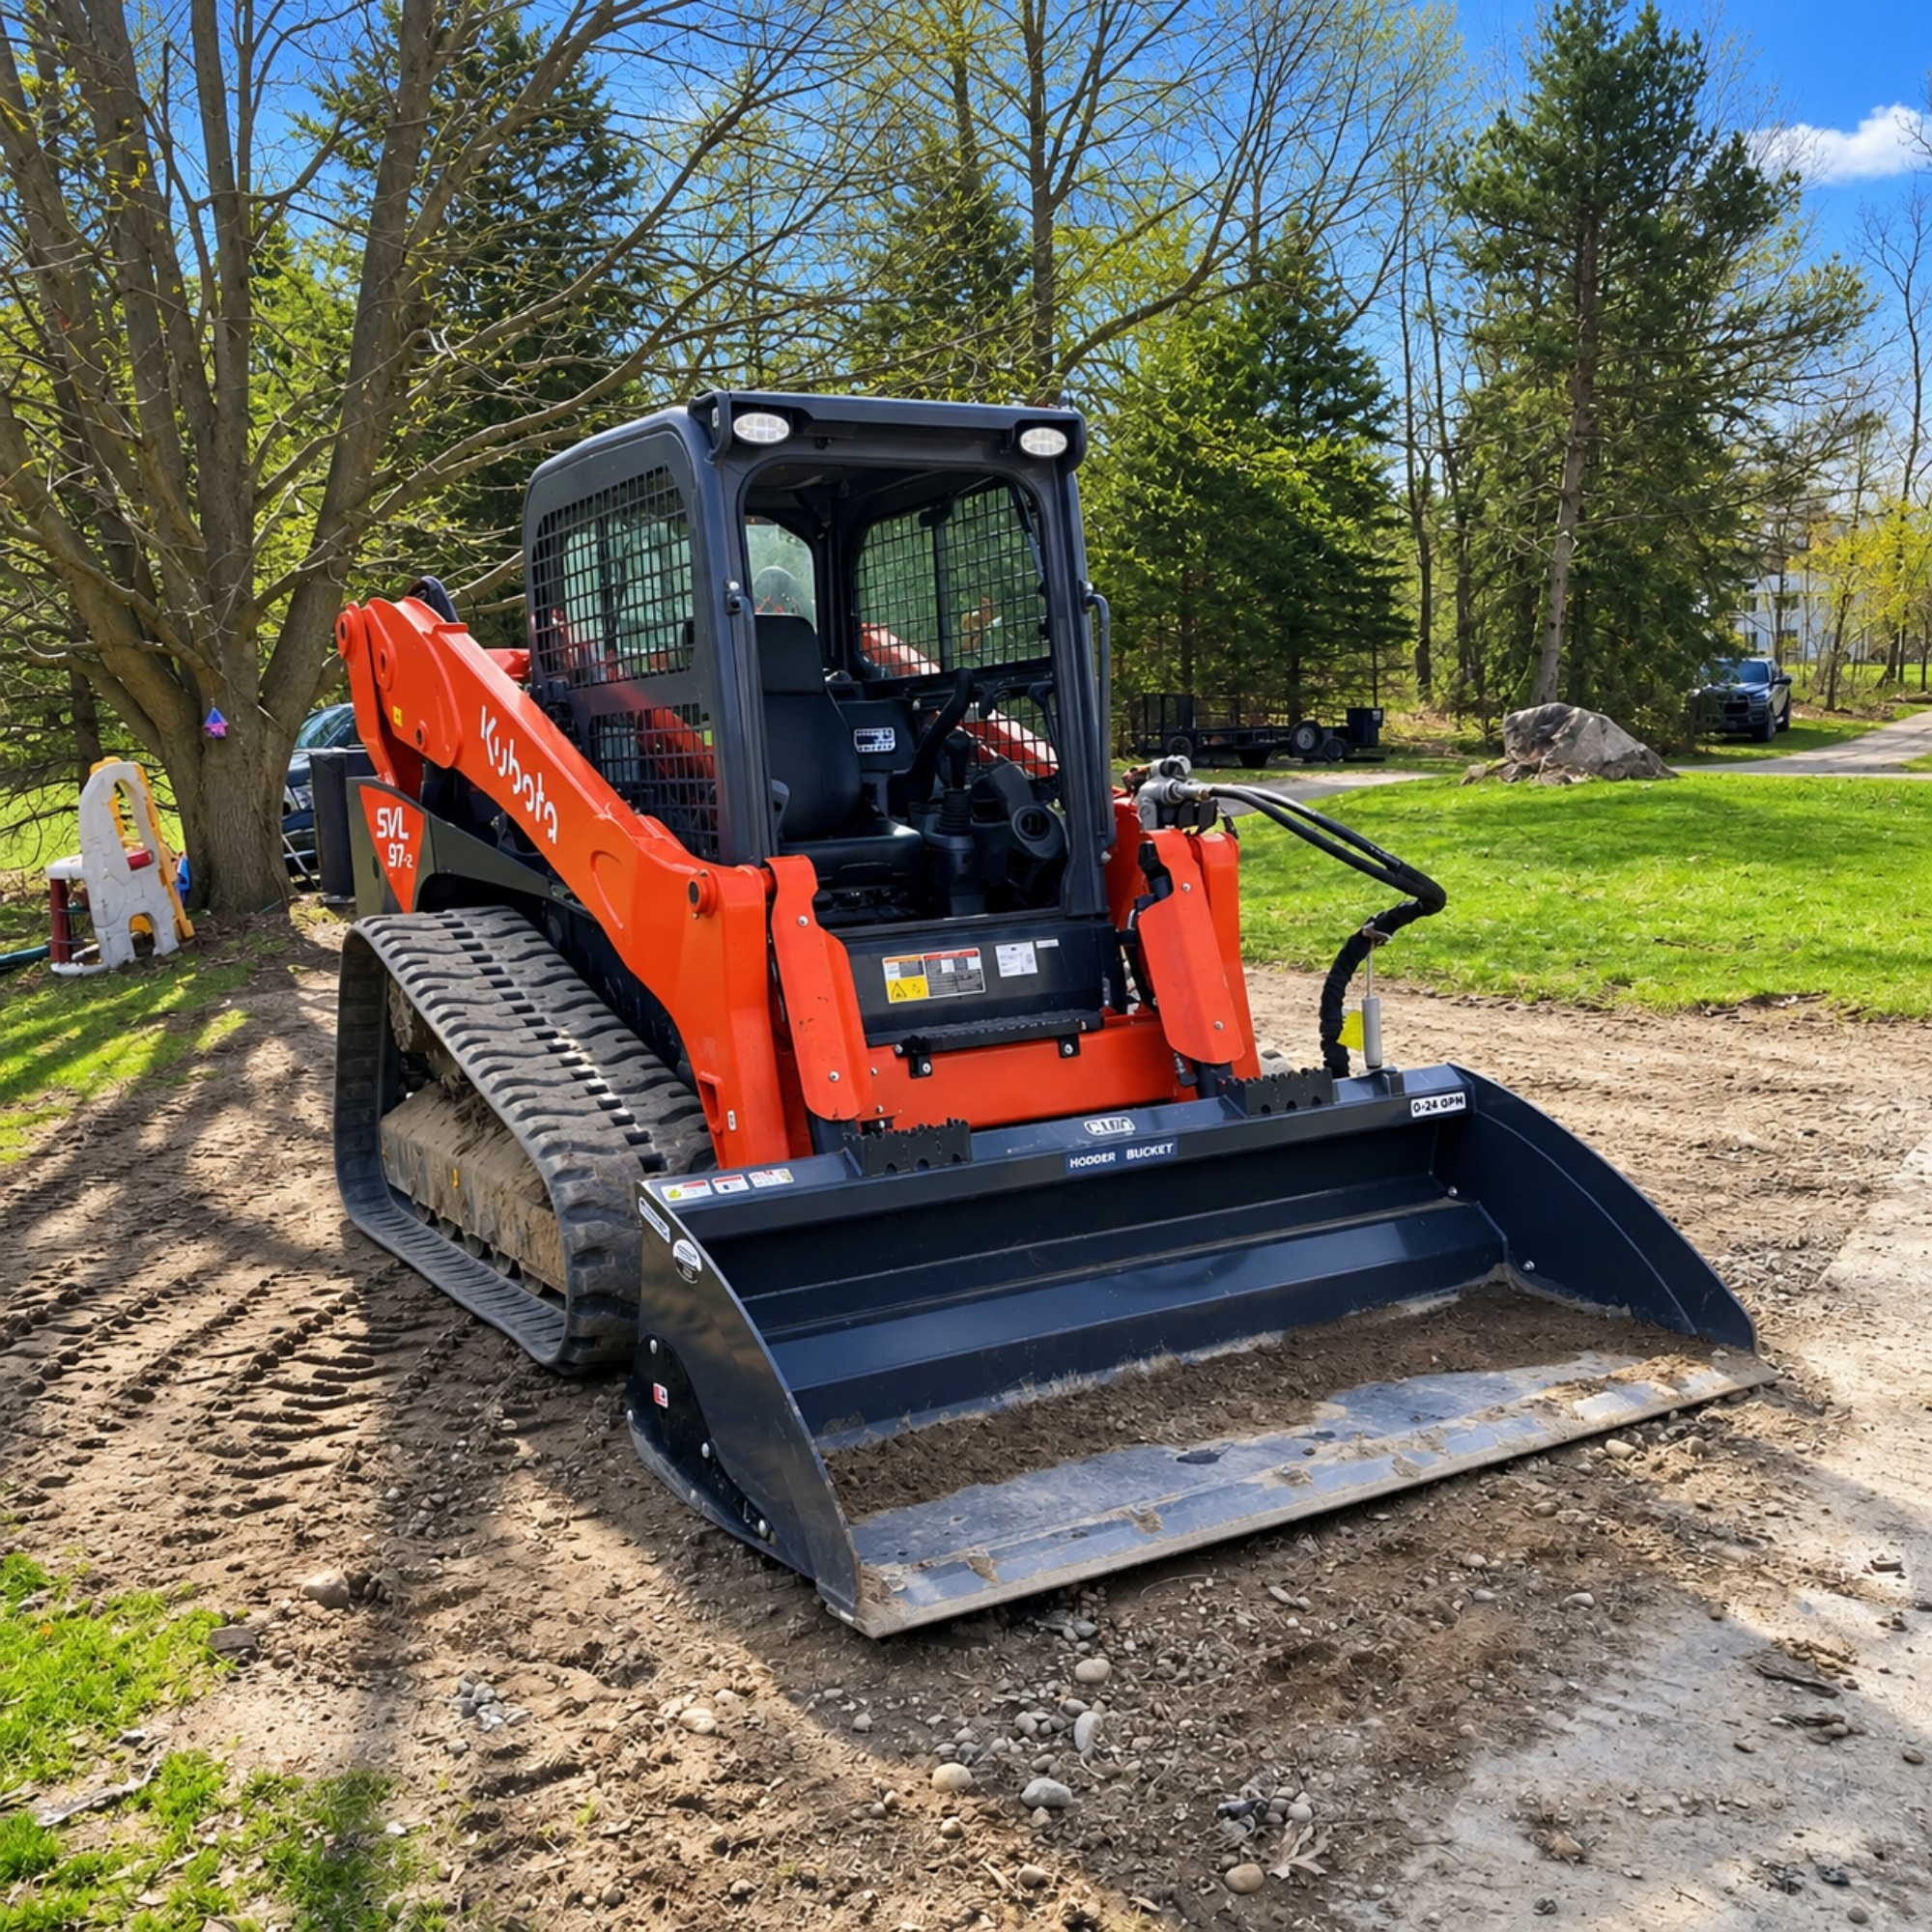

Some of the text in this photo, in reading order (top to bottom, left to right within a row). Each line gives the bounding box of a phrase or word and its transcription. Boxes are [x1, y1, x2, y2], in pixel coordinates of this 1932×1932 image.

[480, 705, 557, 844] Kubota
[376, 807, 410, 840] SVL
[387, 842, 413, 868] 97-2
[1125, 1143, 1174, 1160] BUCKET
